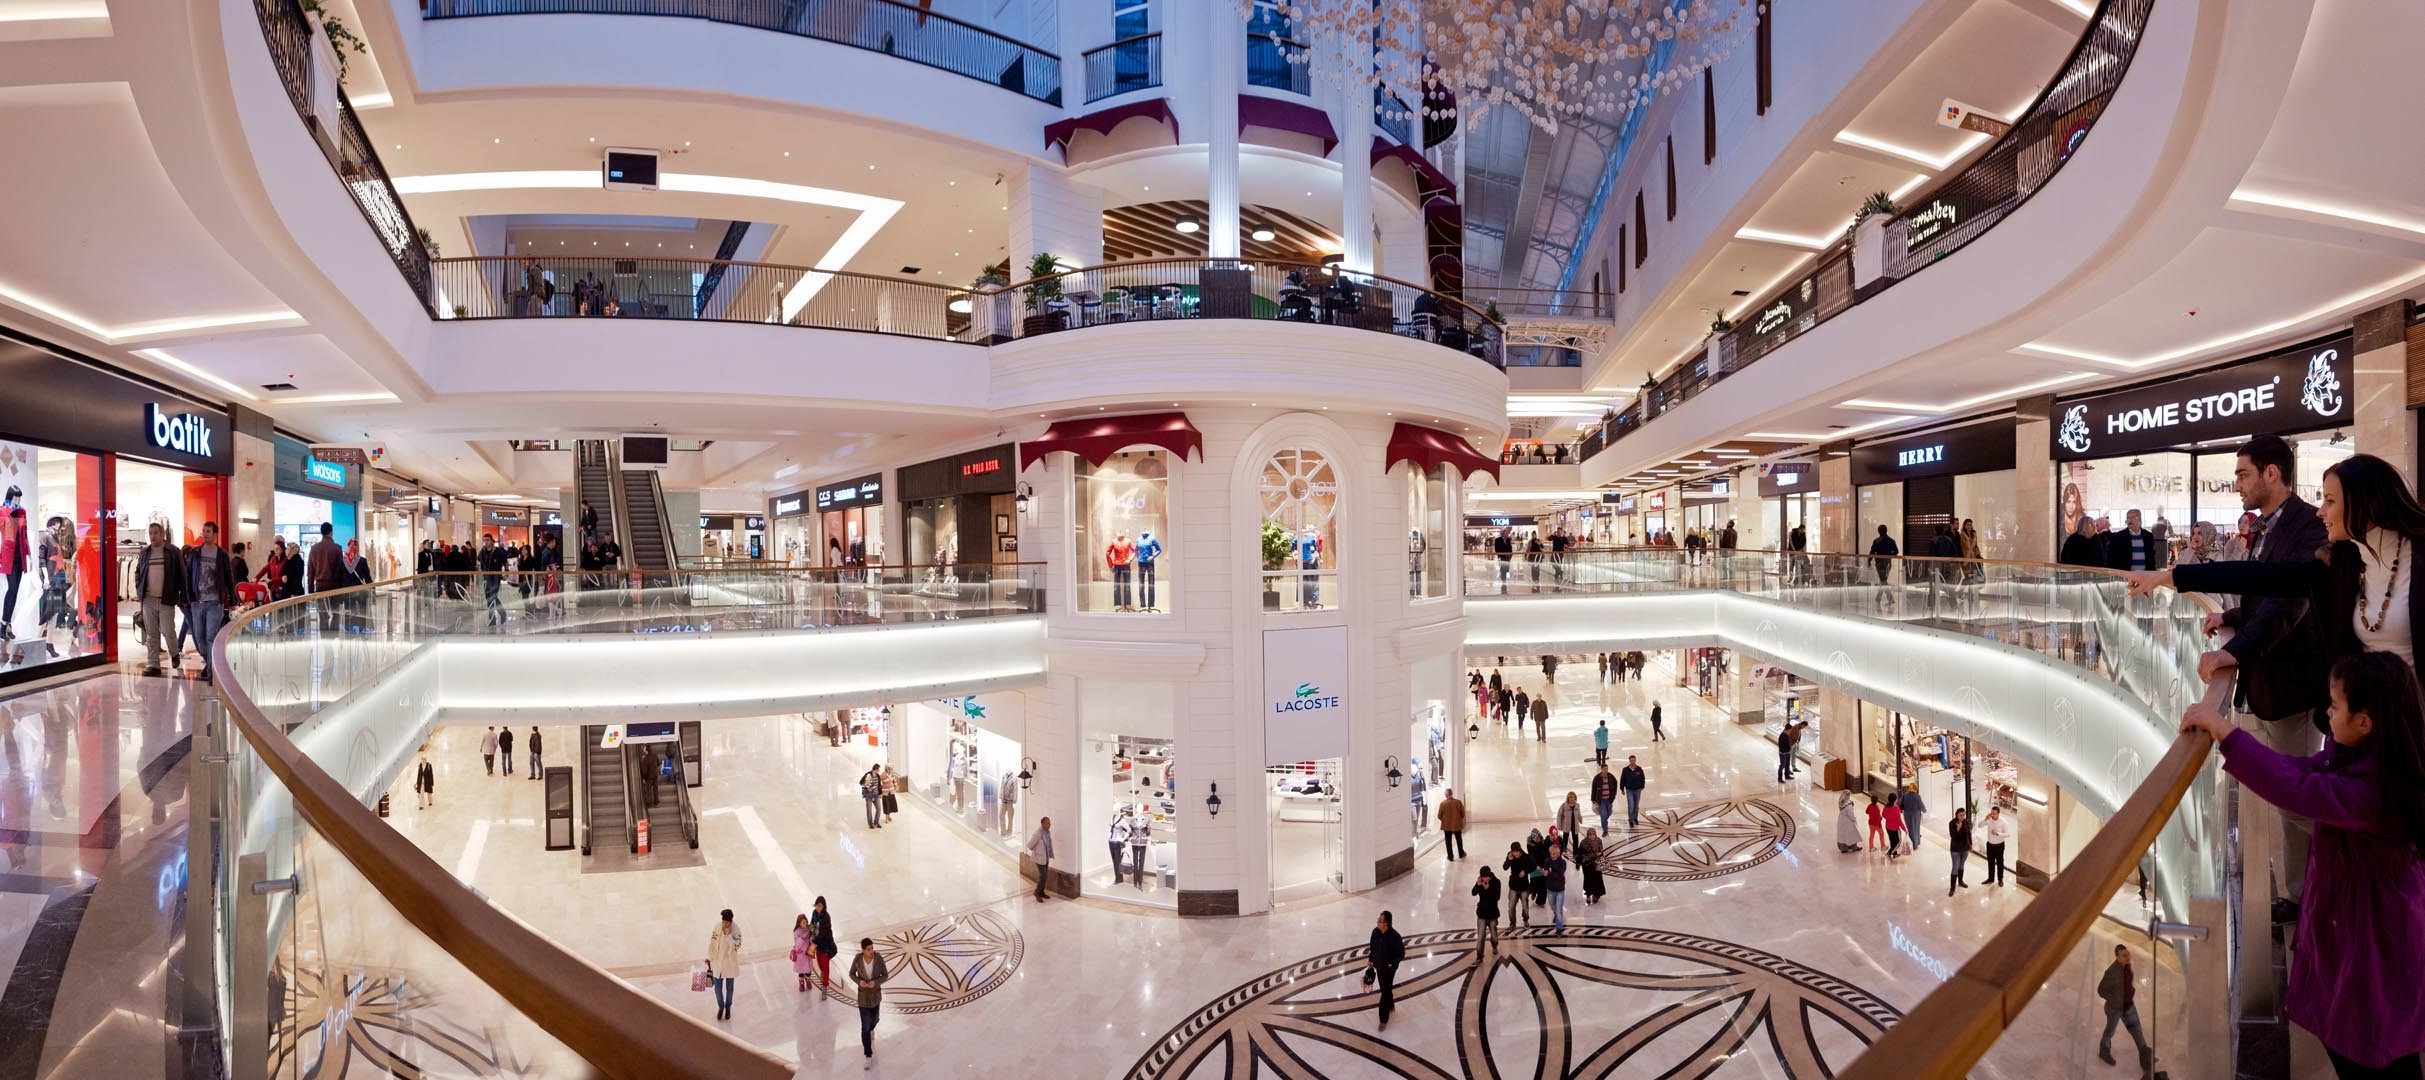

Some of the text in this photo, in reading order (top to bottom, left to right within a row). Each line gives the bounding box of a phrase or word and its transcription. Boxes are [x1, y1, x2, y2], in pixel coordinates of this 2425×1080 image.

[2107, 383, 2275, 435] HOME STORE
[153, 402, 212, 457] batik
[1899, 445, 1944, 467] HERRY
[312, 461, 342, 484] watsons
[1276, 696, 1339, 713] LACOSTE
